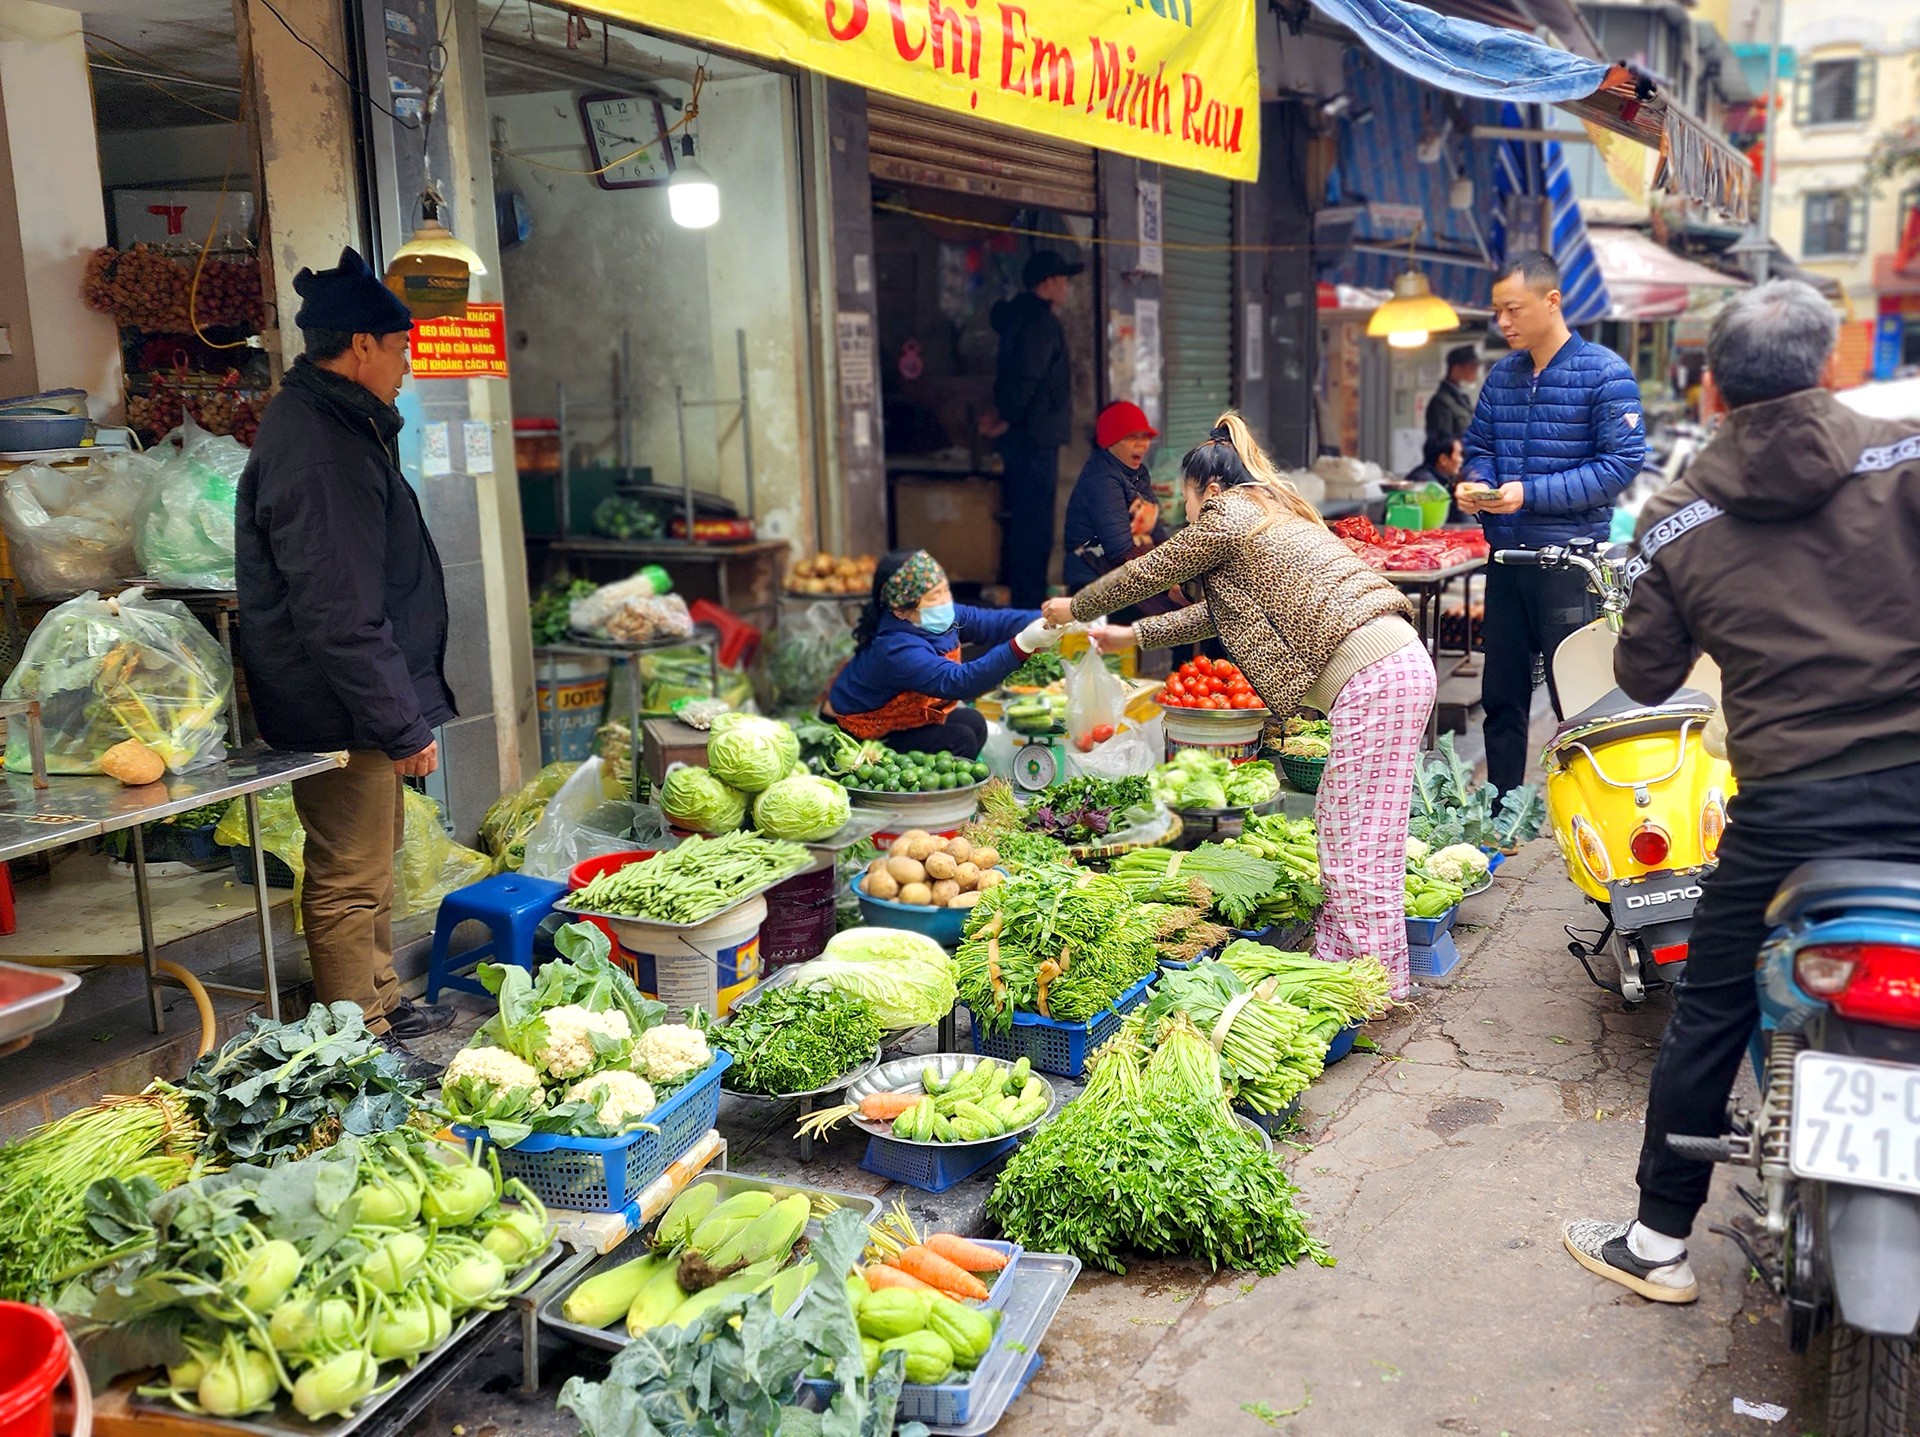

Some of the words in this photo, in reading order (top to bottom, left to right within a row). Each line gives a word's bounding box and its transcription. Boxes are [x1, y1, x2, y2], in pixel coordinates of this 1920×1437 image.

[998, 3, 1075, 107] Em
[1086, 36, 1172, 136] Minh
[1182, 73, 1244, 153] Rau
[617, 102, 628, 114] 12
[634, 165, 641, 176] 6
[463, 326, 490, 338] TRANG
[417, 342, 433, 353] KHI
[1805, 1117, 1920, 1183] 741.
